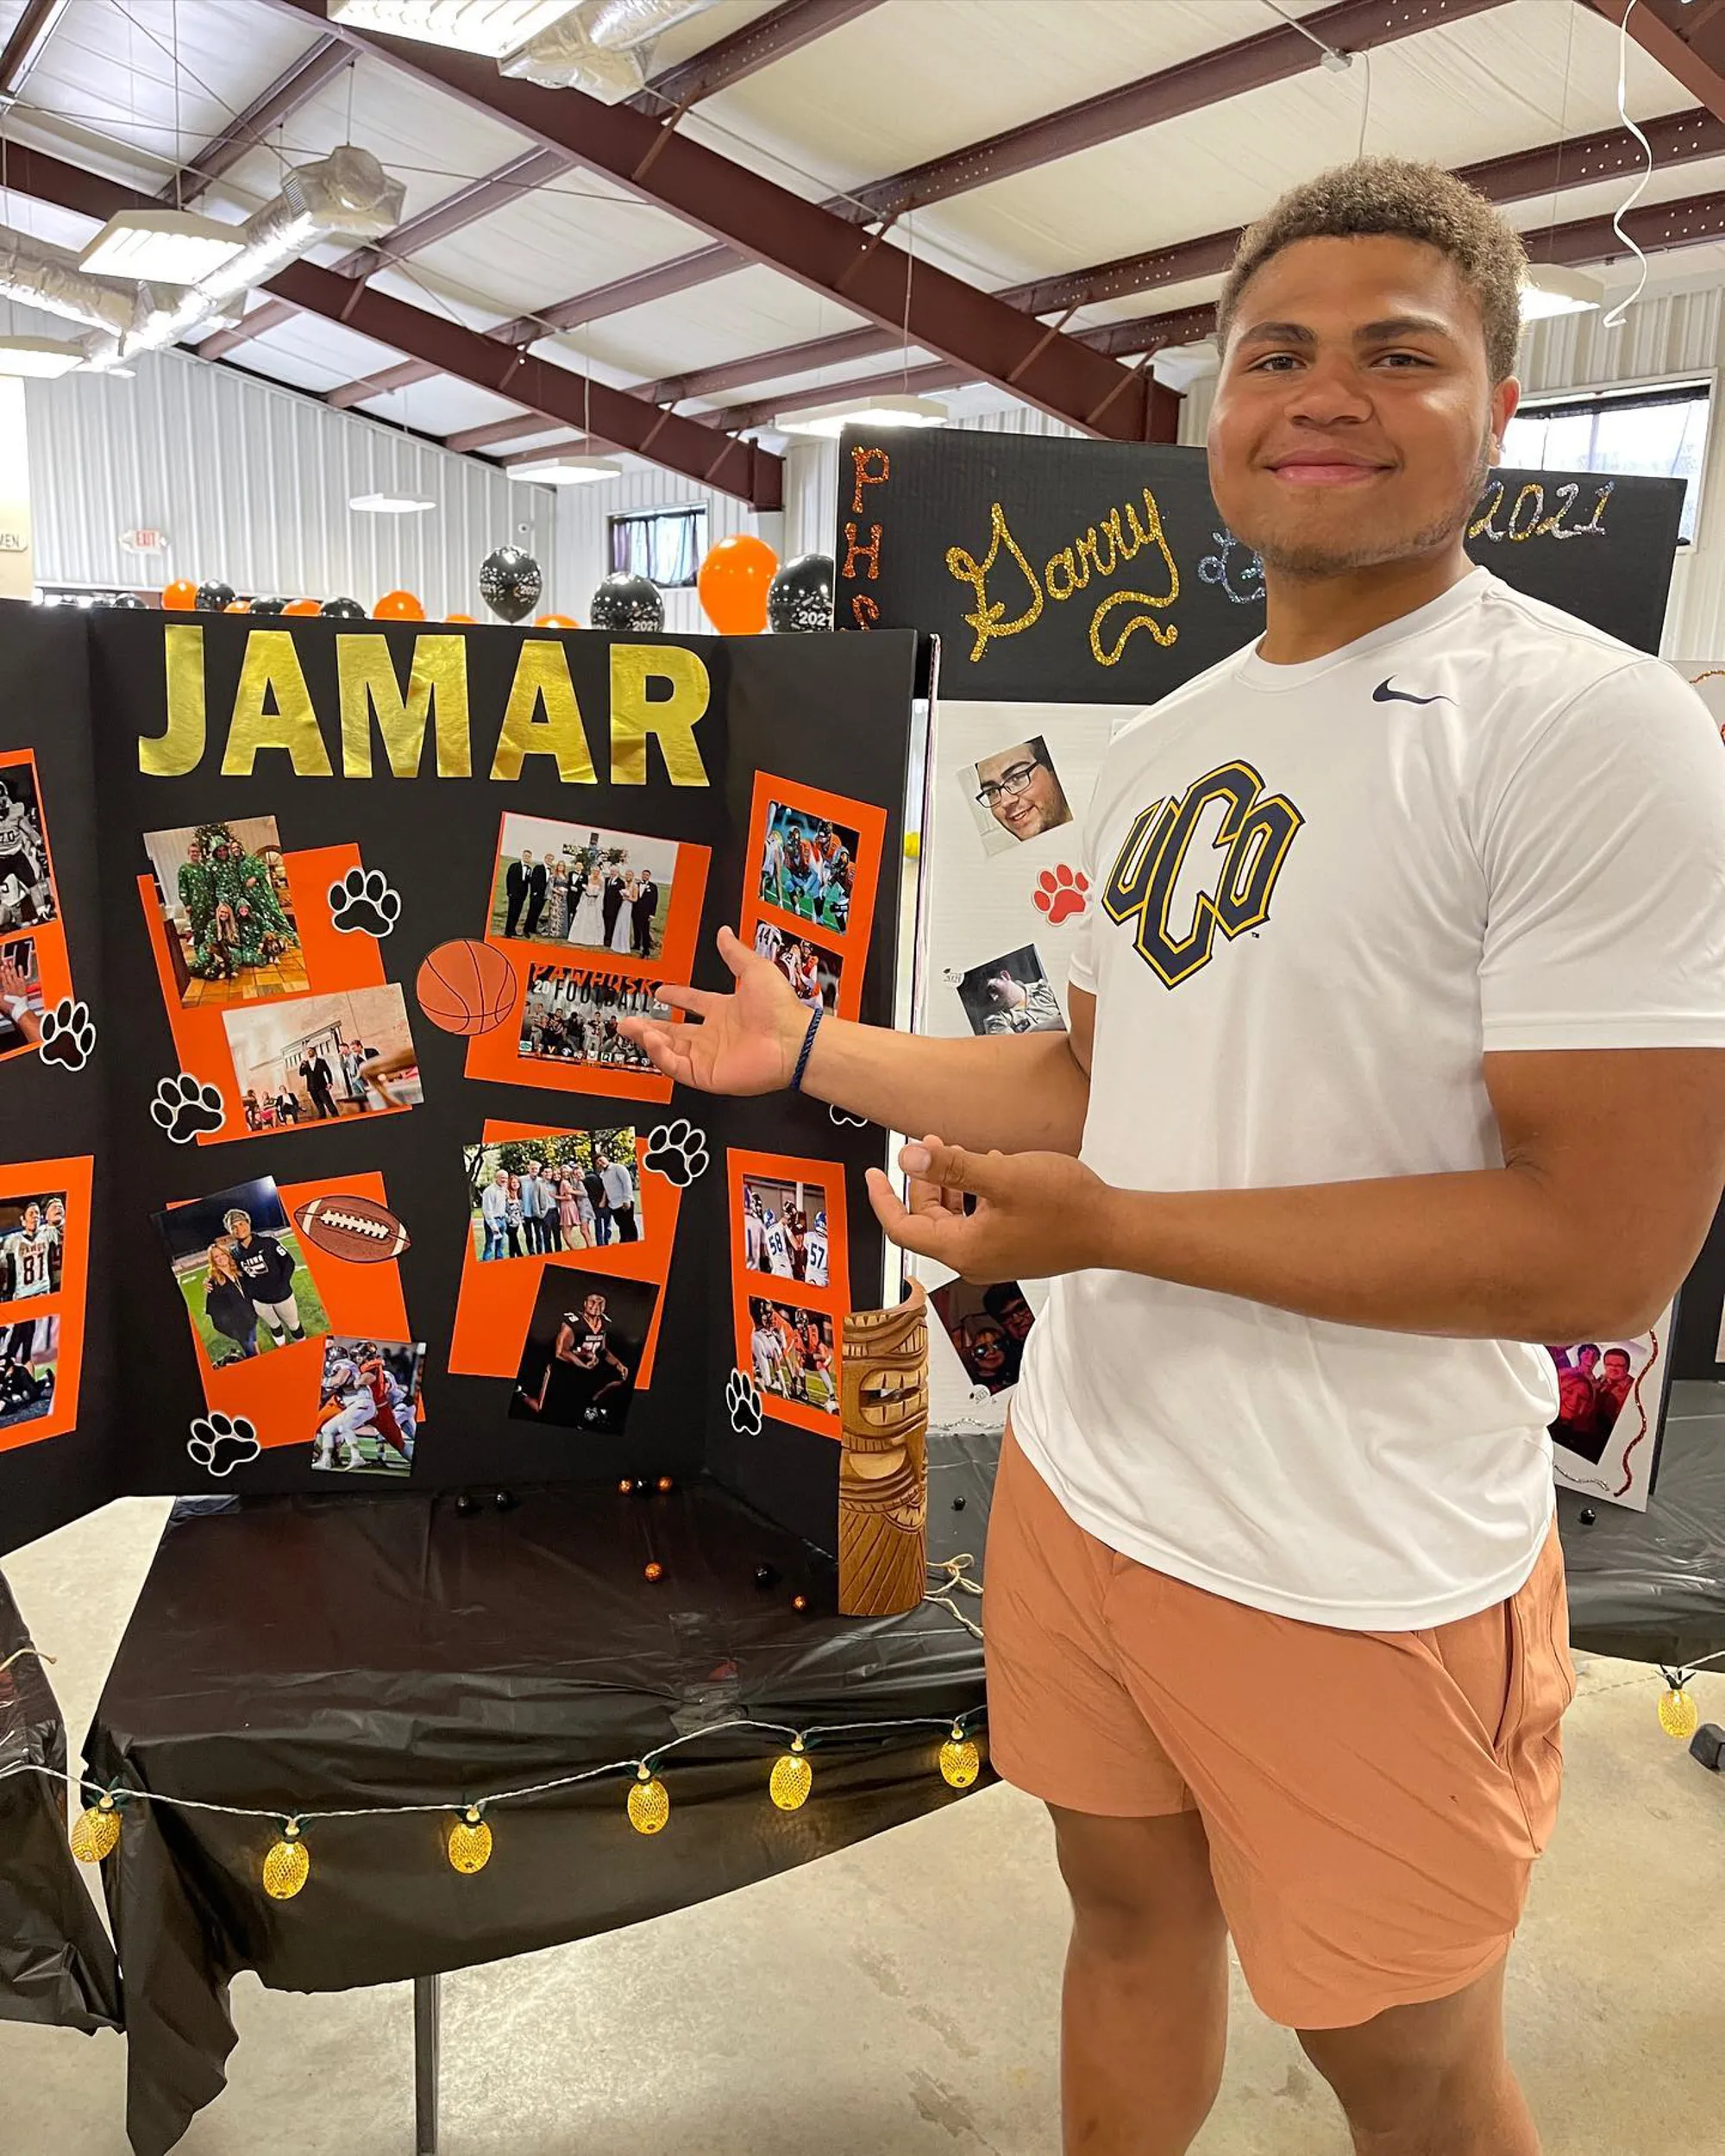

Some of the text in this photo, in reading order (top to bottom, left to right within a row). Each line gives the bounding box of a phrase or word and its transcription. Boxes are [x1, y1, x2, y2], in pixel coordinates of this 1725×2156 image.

[1468, 480, 1615, 542] 2021
[135, 531, 156, 547] EXIT
[945, 487, 1179, 666] Garry
[139, 625, 711, 787] JAMAR
[533, 964, 660, 999] PAWHUSK
[533, 979, 551, 994] 20
[555, 978, 650, 1013] FOOTBALL
[768, 1231, 783, 1255] 58
[810, 1242, 825, 1270] 57
[23, 1254, 43, 1285] 81
